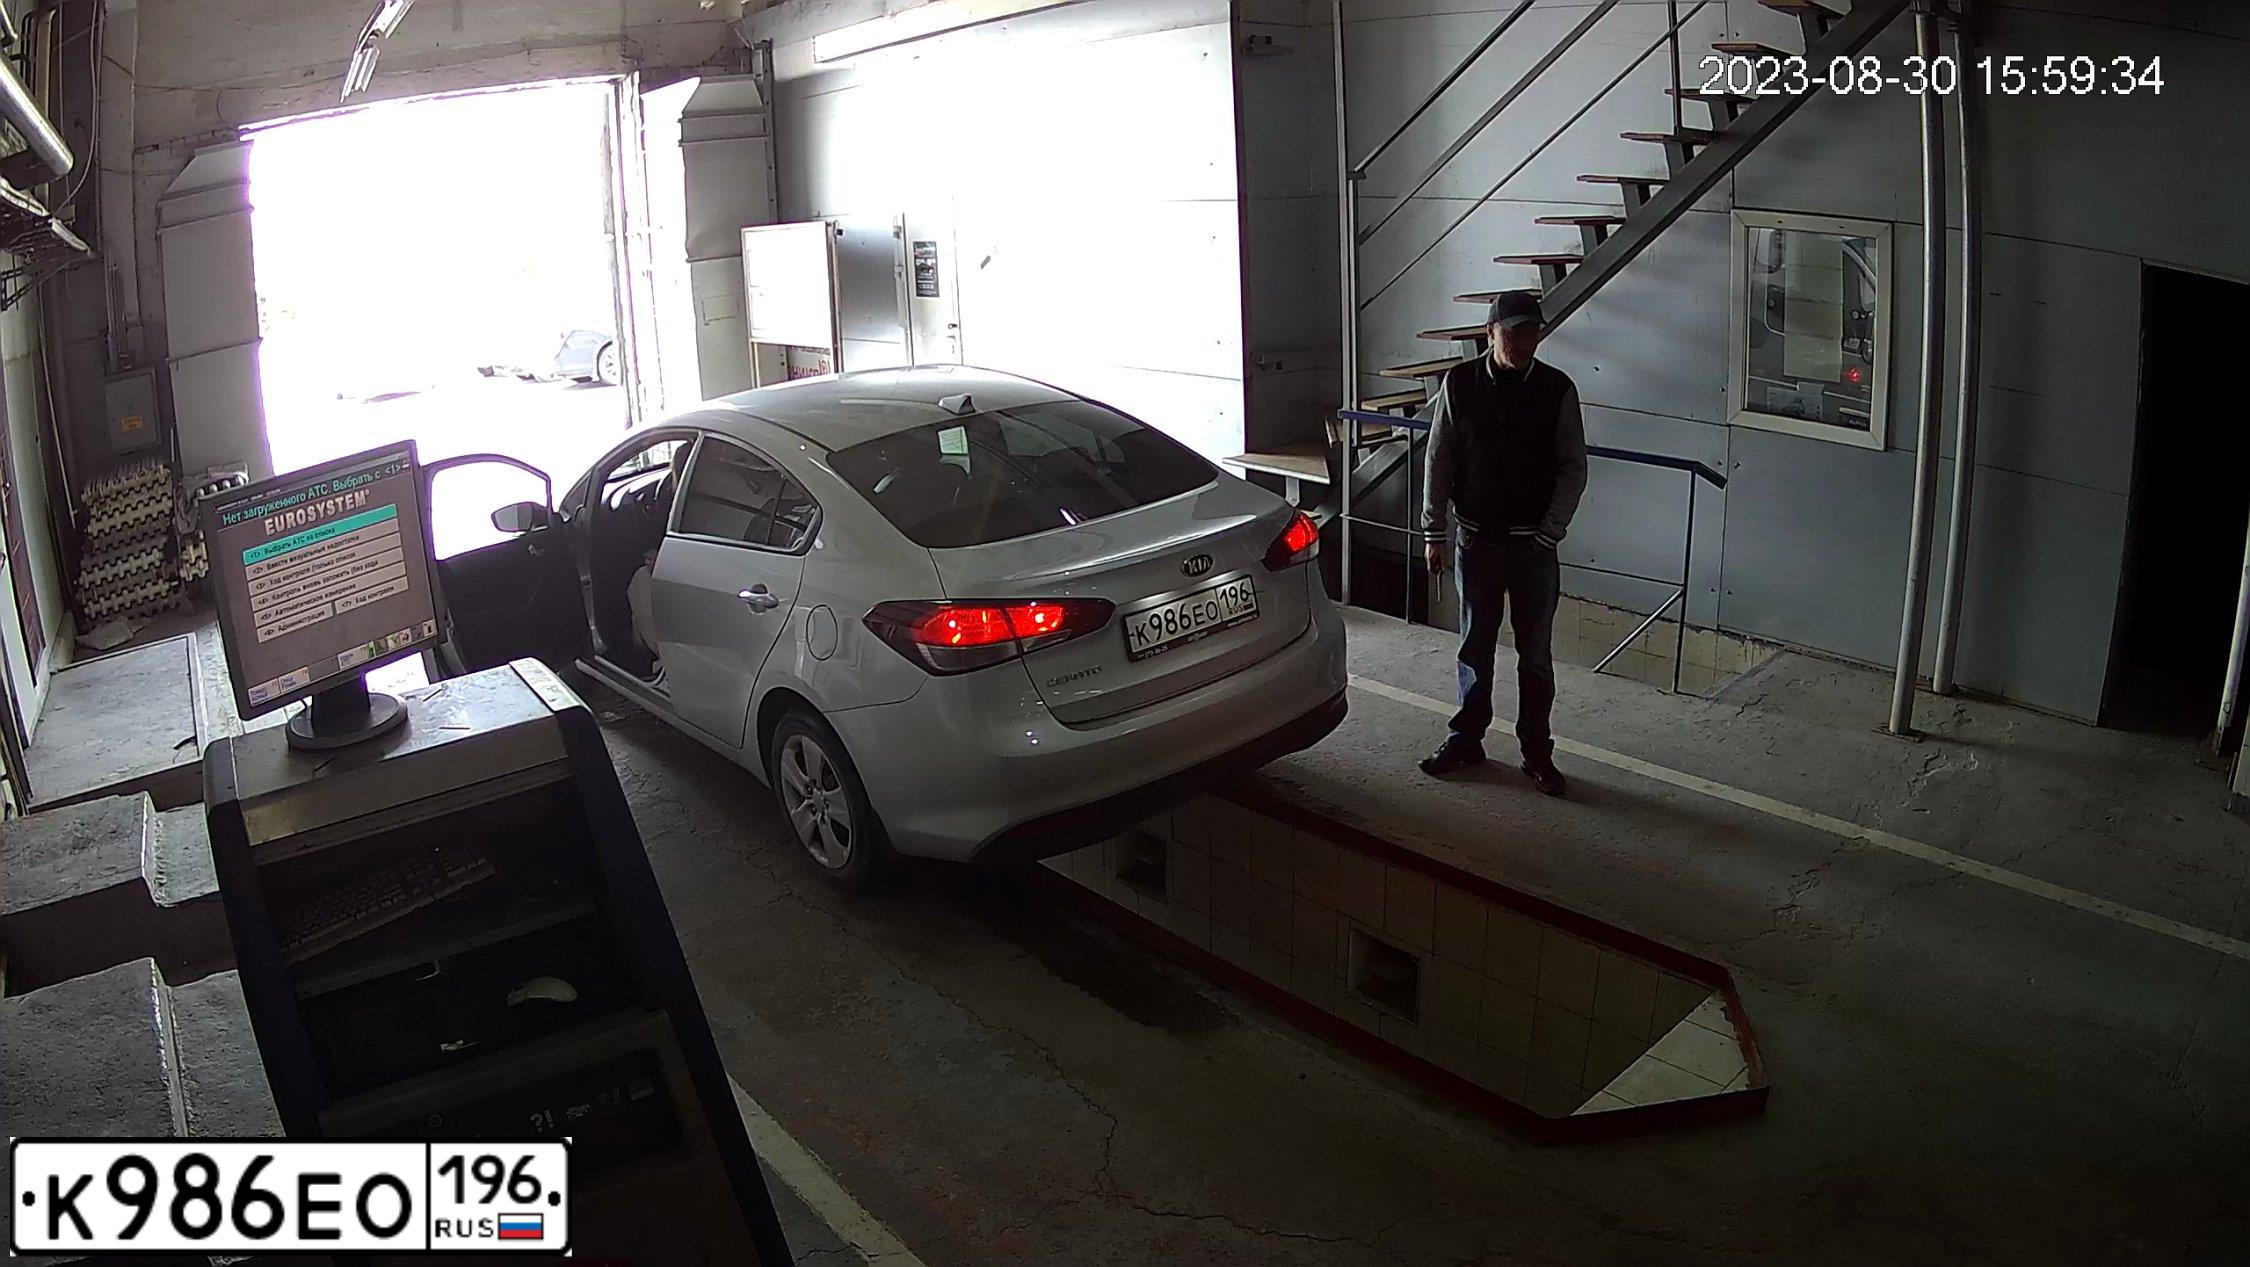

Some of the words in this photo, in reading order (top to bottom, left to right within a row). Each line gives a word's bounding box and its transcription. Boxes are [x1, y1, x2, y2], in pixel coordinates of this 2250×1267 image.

[222, 513, 241, 525] Нет
[243, 492, 306, 520] загруженного
[333, 474, 373, 491] Выбрать
[265, 490, 366, 535] EUROSYSTEM
[1186, 556, 1213, 575] KIA
[1219, 582, 1250, 608] 196
